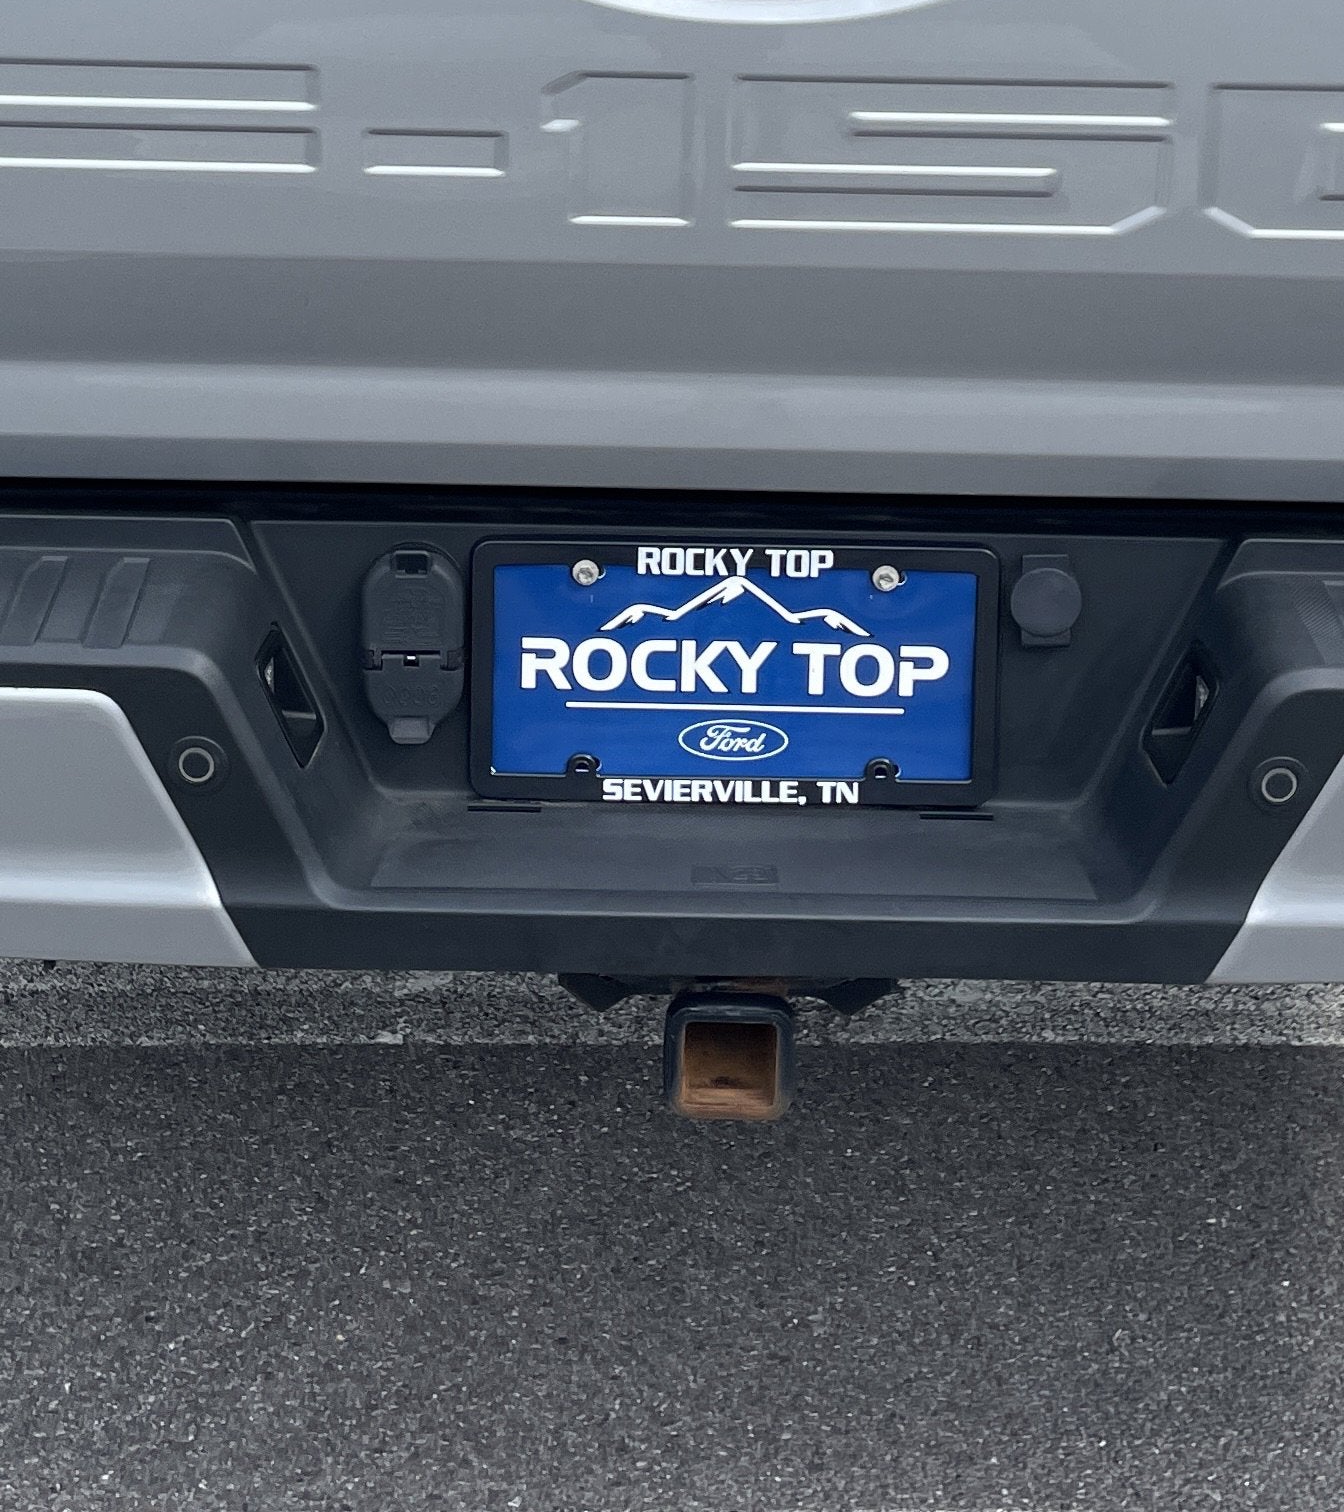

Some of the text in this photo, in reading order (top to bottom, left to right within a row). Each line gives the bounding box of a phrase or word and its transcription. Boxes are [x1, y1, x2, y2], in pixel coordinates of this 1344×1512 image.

[638, 546, 834, 577] ROCKY TOP
[521, 636, 949, 697] ROCKY TOP
[699, 724, 767, 753] Ford
[602, 778, 859, 805] SEVIERVILLE, TN
